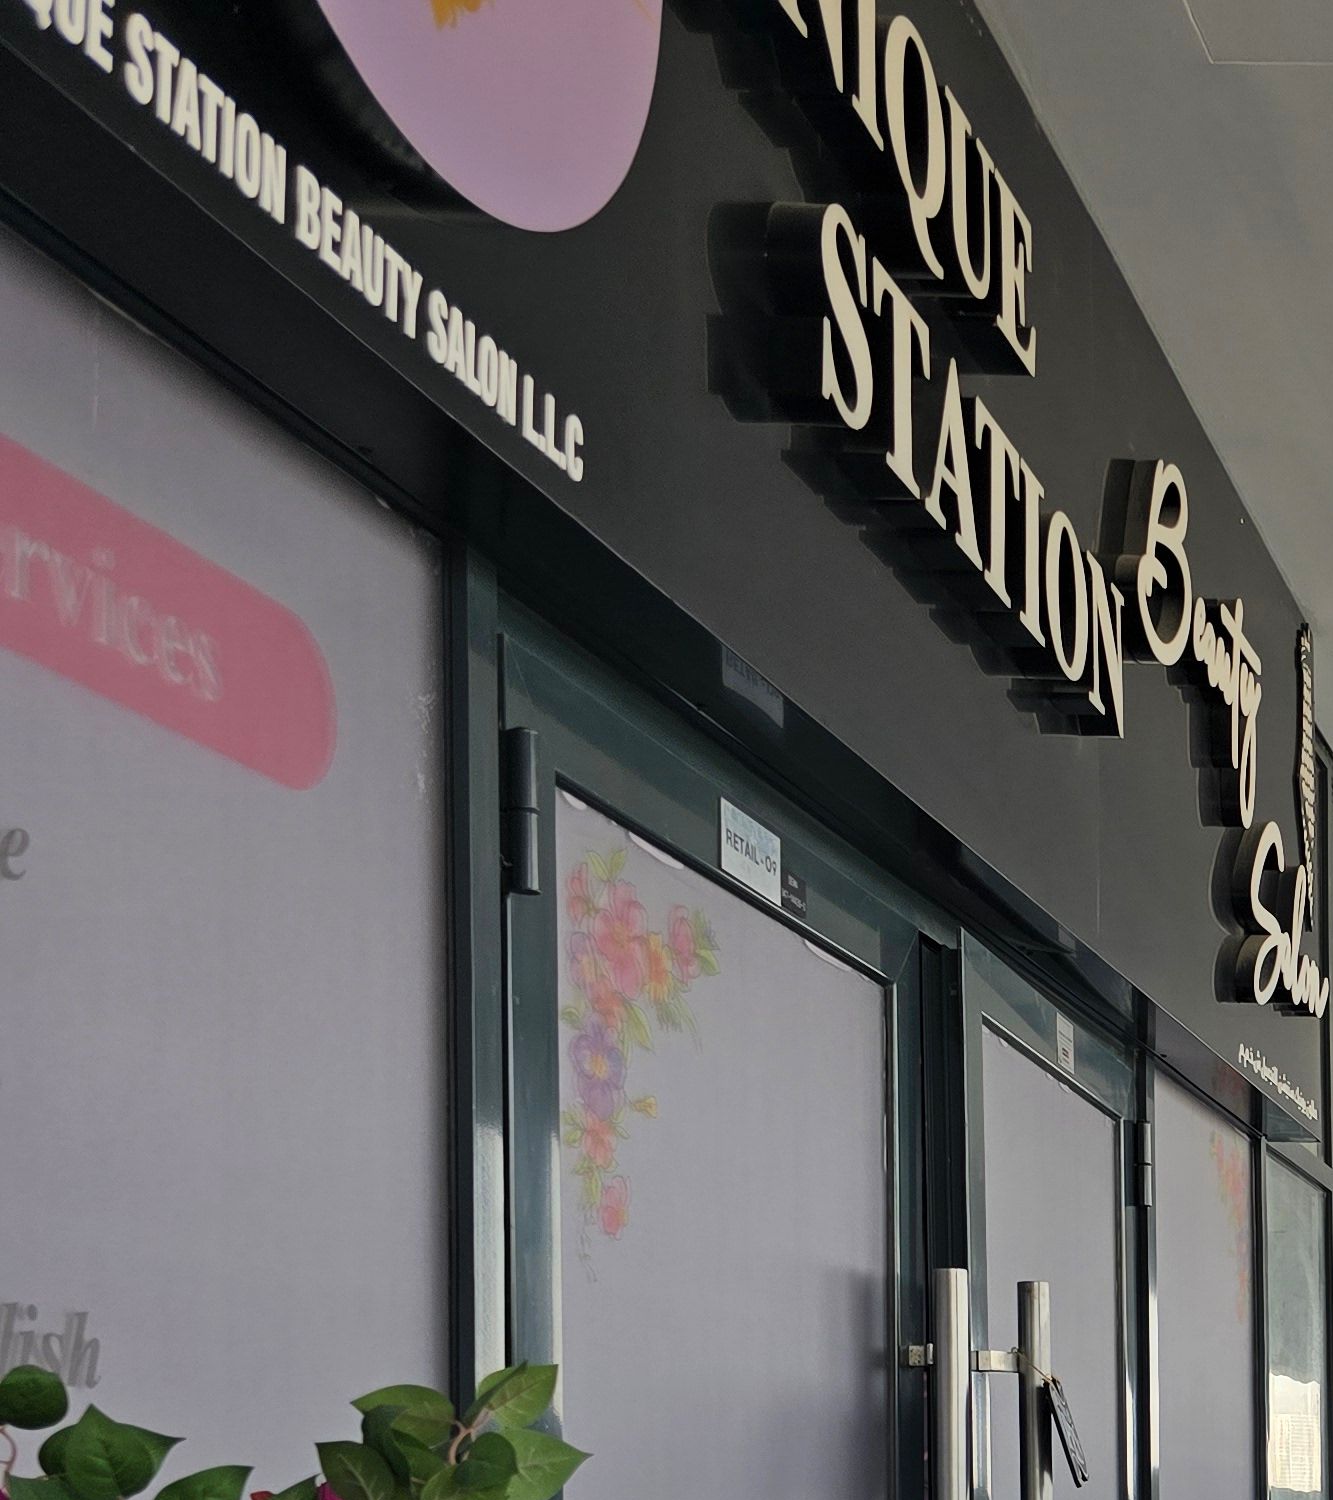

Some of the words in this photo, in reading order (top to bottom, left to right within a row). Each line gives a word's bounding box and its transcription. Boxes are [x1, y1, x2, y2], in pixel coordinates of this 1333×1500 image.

[123, 12, 287, 224] STATION
[296, 164, 423, 340] BEAUTY
[427, 289, 518, 427] SALON
[821, 203, 1124, 738] STATION
[1137, 460, 1262, 829] Beauty
[1251, 820, 1330, 1019] Salon
